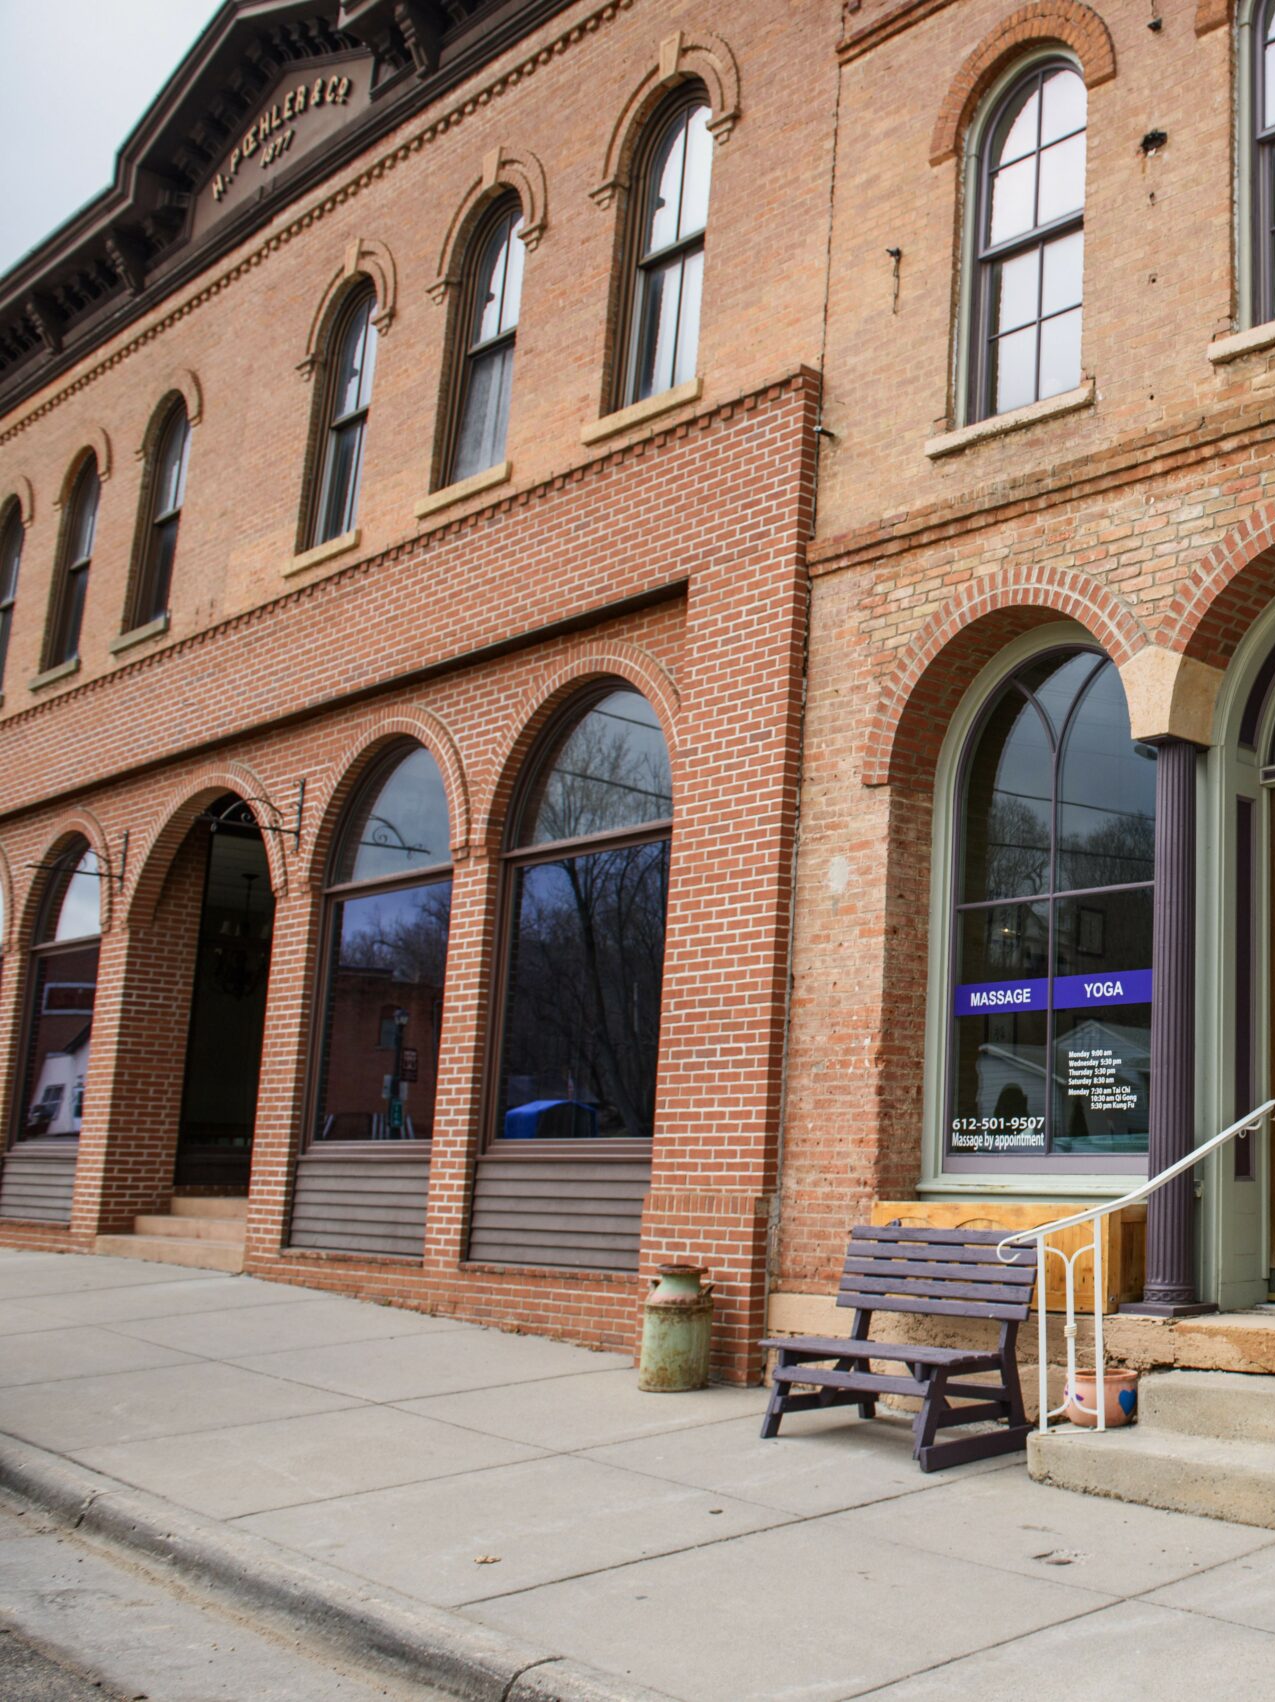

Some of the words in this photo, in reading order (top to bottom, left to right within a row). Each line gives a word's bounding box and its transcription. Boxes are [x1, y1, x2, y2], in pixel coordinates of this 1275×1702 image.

[310, 77, 324, 107] &
[260, 129, 295, 168] 1877
[1084, 981, 1124, 998] YOGA
[970, 988, 1032, 1007] MASSAGE
[1068, 1050, 1090, 1058] Monday
[1091, 1049, 1103, 1057] 9:00
[1068, 1058, 1100, 1067] Wednesday
[1100, 1058, 1112, 1066] 5:30
[1068, 1068, 1093, 1077] Thursday
[1094, 1067, 1106, 1075] 5:30
[1106, 1068, 1116, 1076] pm
[1068, 1077, 1092, 1086] Saturday
[1068, 1088, 1090, 1096] Monday
[1112, 1086, 1121, 1094] Tai
[1121, 1085, 1131, 1093] Chi
[1122, 1094, 1137, 1103] Gong
[1090, 1102, 1103, 1110] 5:30
[1103, 1102, 1112, 1111] pm
[1112, 1101, 1127, 1111] Kung
[952, 1116, 1045, 1130] 612-501-9507
[952, 1131, 984, 1151] Massage
[984, 1130, 995, 1150] by
[994, 1130, 1045, 1150] appointment
